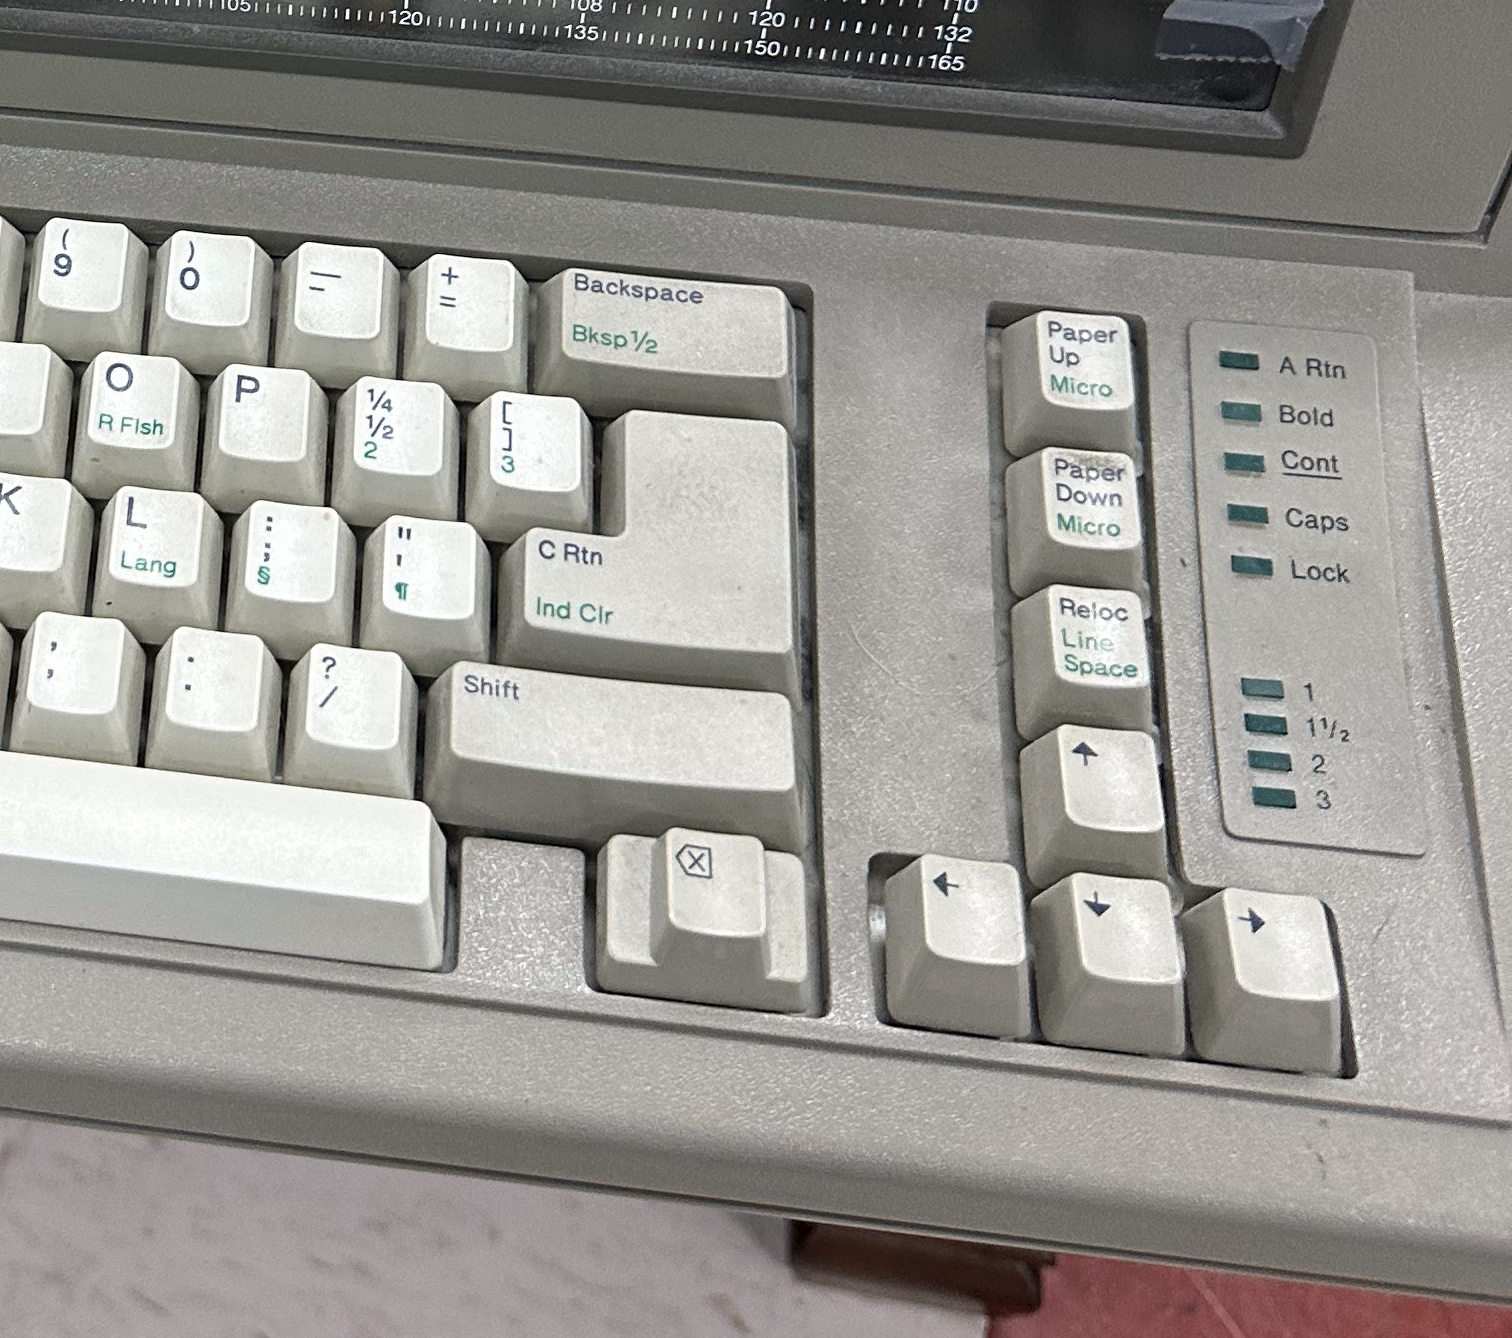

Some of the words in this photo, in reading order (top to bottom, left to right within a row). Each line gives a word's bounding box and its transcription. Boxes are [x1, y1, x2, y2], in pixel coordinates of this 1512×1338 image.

[748, 11, 785, 27] 120
[933, 26, 973, 43] 132
[388, 10, 423, 26] 120
[564, 24, 598, 40] 135
[743, 40, 781, 57] 150
[927, 55, 965, 72] 165
[54, 254, 72, 277] 9
[574, 273, 704, 304] Backspace
[1048, 321, 1118, 344] Paper
[1050, 345, 1080, 367] Up
[1280, 356, 1296, 375] A
[1306, 358, 1346, 379] Rtn
[106, 363, 133, 391] O
[235, 375, 260, 402] P
[1051, 374, 1113, 397] Micro
[98, 413, 113, 431] R
[502, 401, 512, 424] [
[1280, 405, 1333, 427] Bold
[364, 441, 377, 459] 2
[502, 428, 512, 452] ]
[501, 456, 515, 473] 3
[1055, 458, 1125, 482] Paper
[1281, 450, 1342, 480] Cont
[1056, 483, 1122, 507] Down
[127, 497, 147, 529] L
[1057, 513, 1120, 537] Micro
[1286, 508, 1349, 534] Caps
[121, 551, 176, 578] Lang
[539, 540, 555, 559] C
[564, 543, 602, 565] Rtn
[1291, 560, 1350, 583] Lock
[537, 597, 570, 619] Ind
[580, 604, 613, 624] Clr
[1060, 597, 1128, 621] Reloc
[1061, 628, 1113, 651] Line
[322, 657, 336, 679] ?
[1064, 654, 1138, 678] Space
[465, 675, 519, 700] Shift
[1304, 683, 1313, 702] 1
[1312, 754, 1326, 774] 2
[1316, 790, 1331, 810] 3
